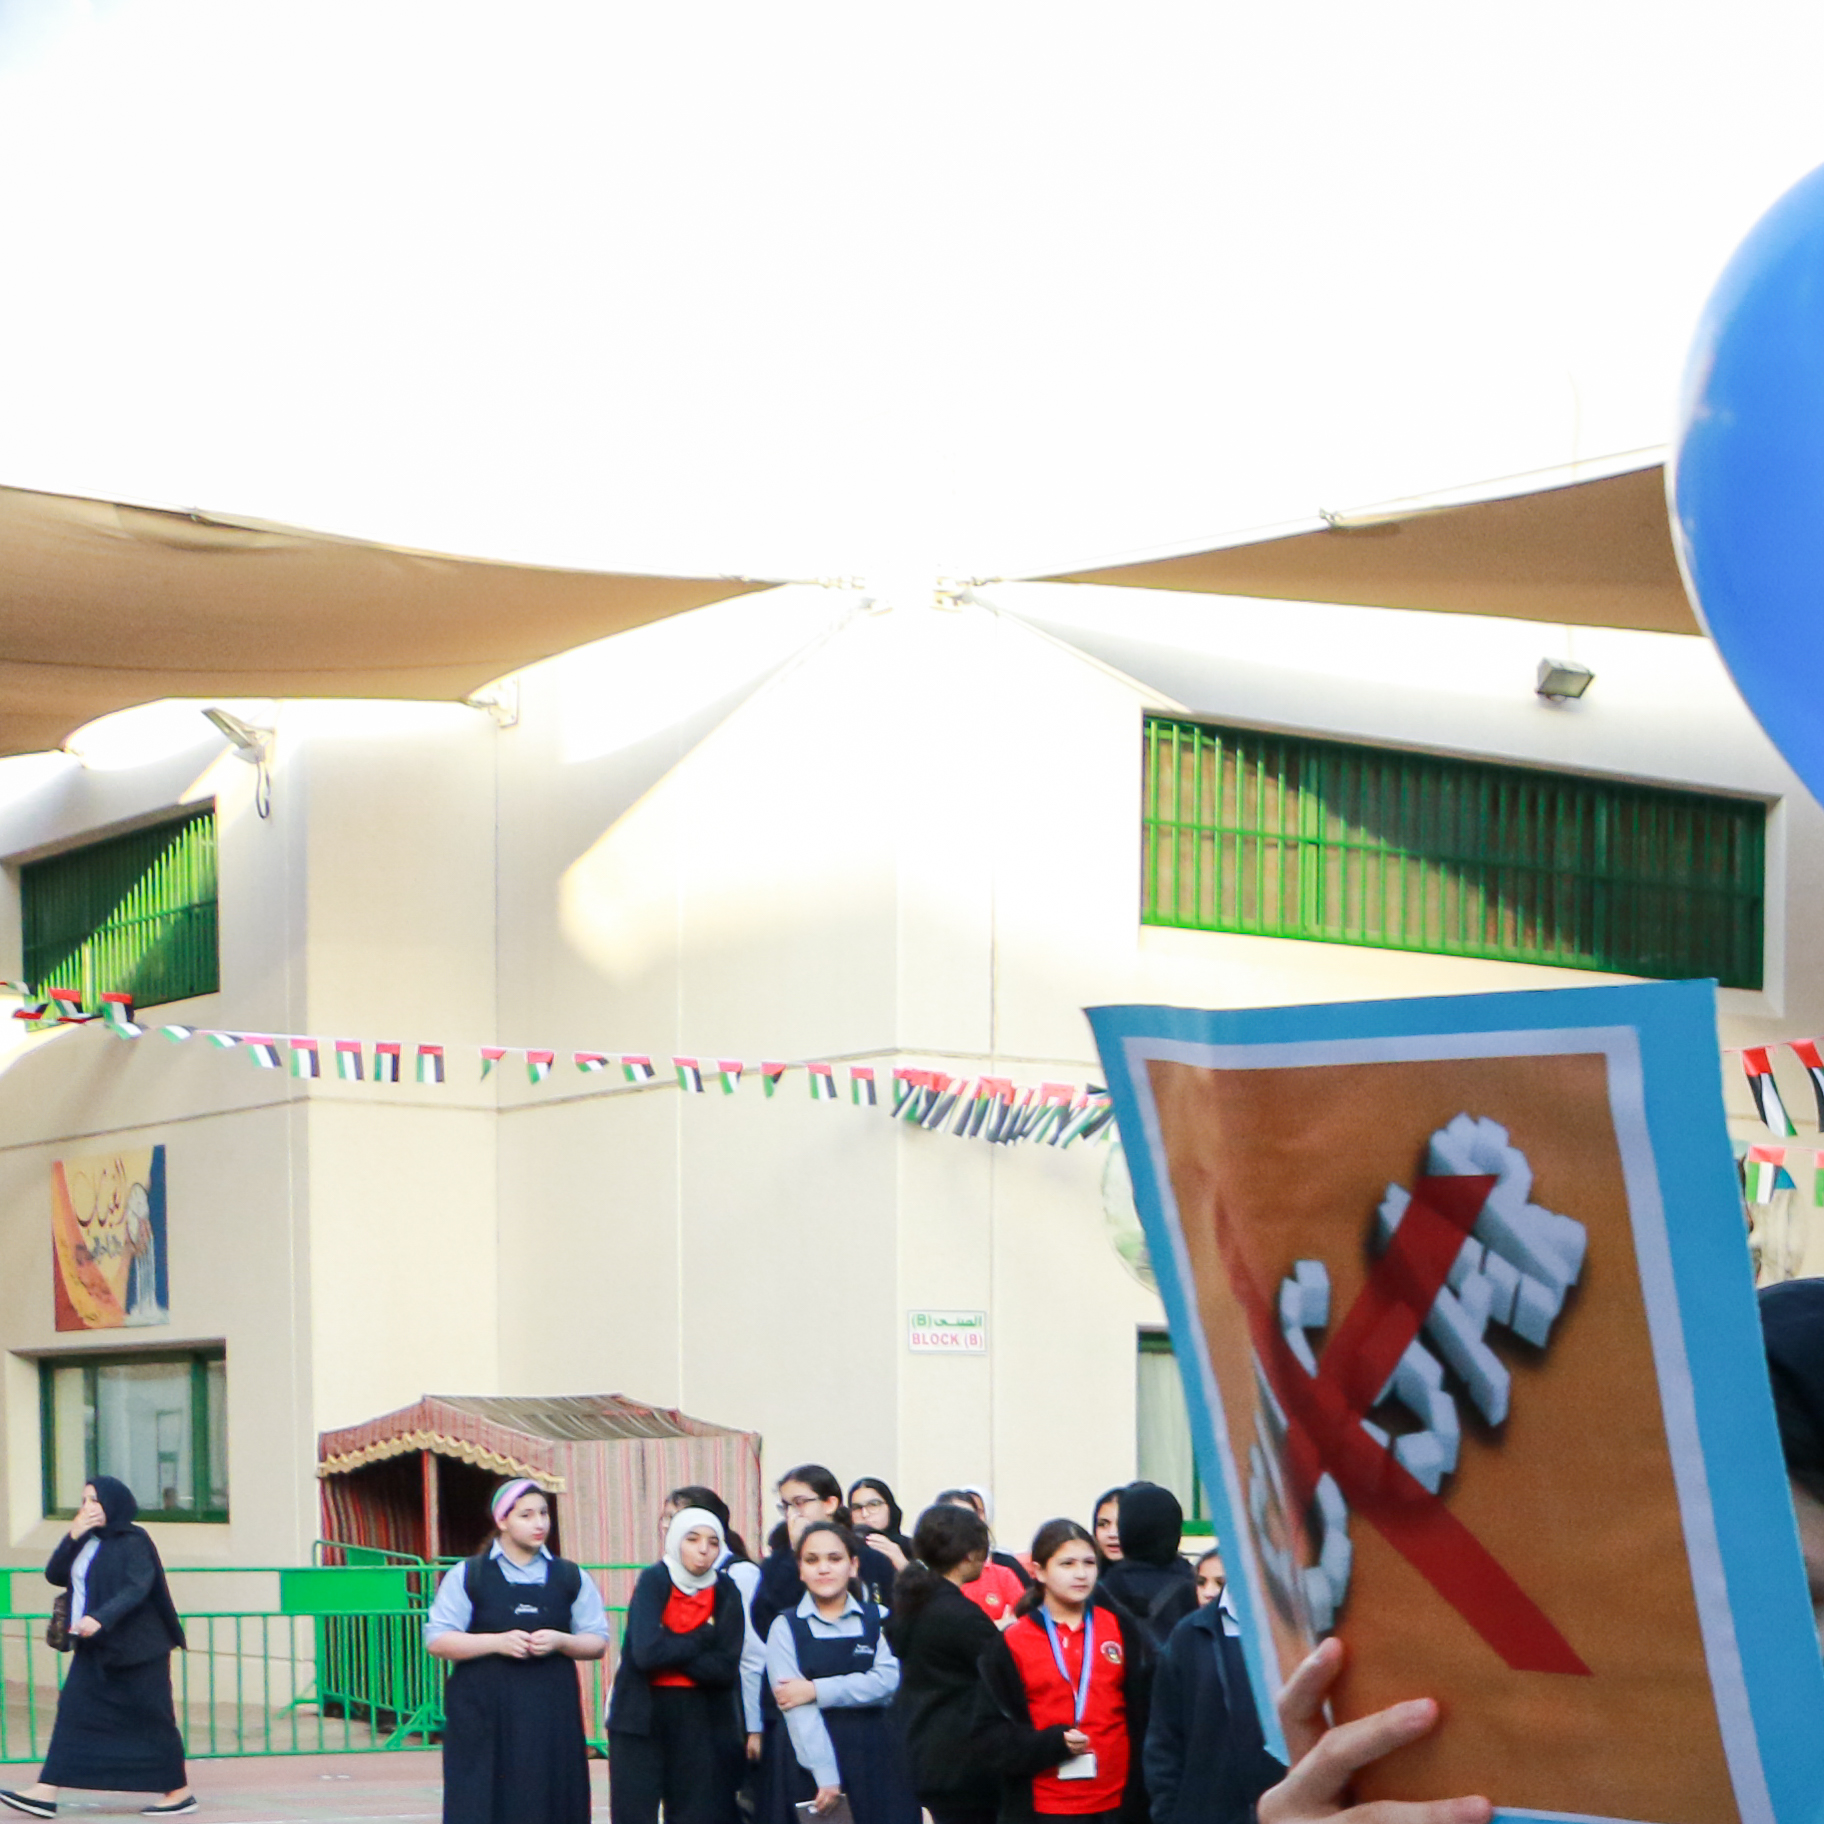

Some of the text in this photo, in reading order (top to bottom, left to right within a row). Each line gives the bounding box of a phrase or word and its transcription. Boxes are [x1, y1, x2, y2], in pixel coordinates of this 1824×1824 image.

[911, 1314, 931, 1329] (B)
[912, 1332, 983, 1349] BLOCK (B)
